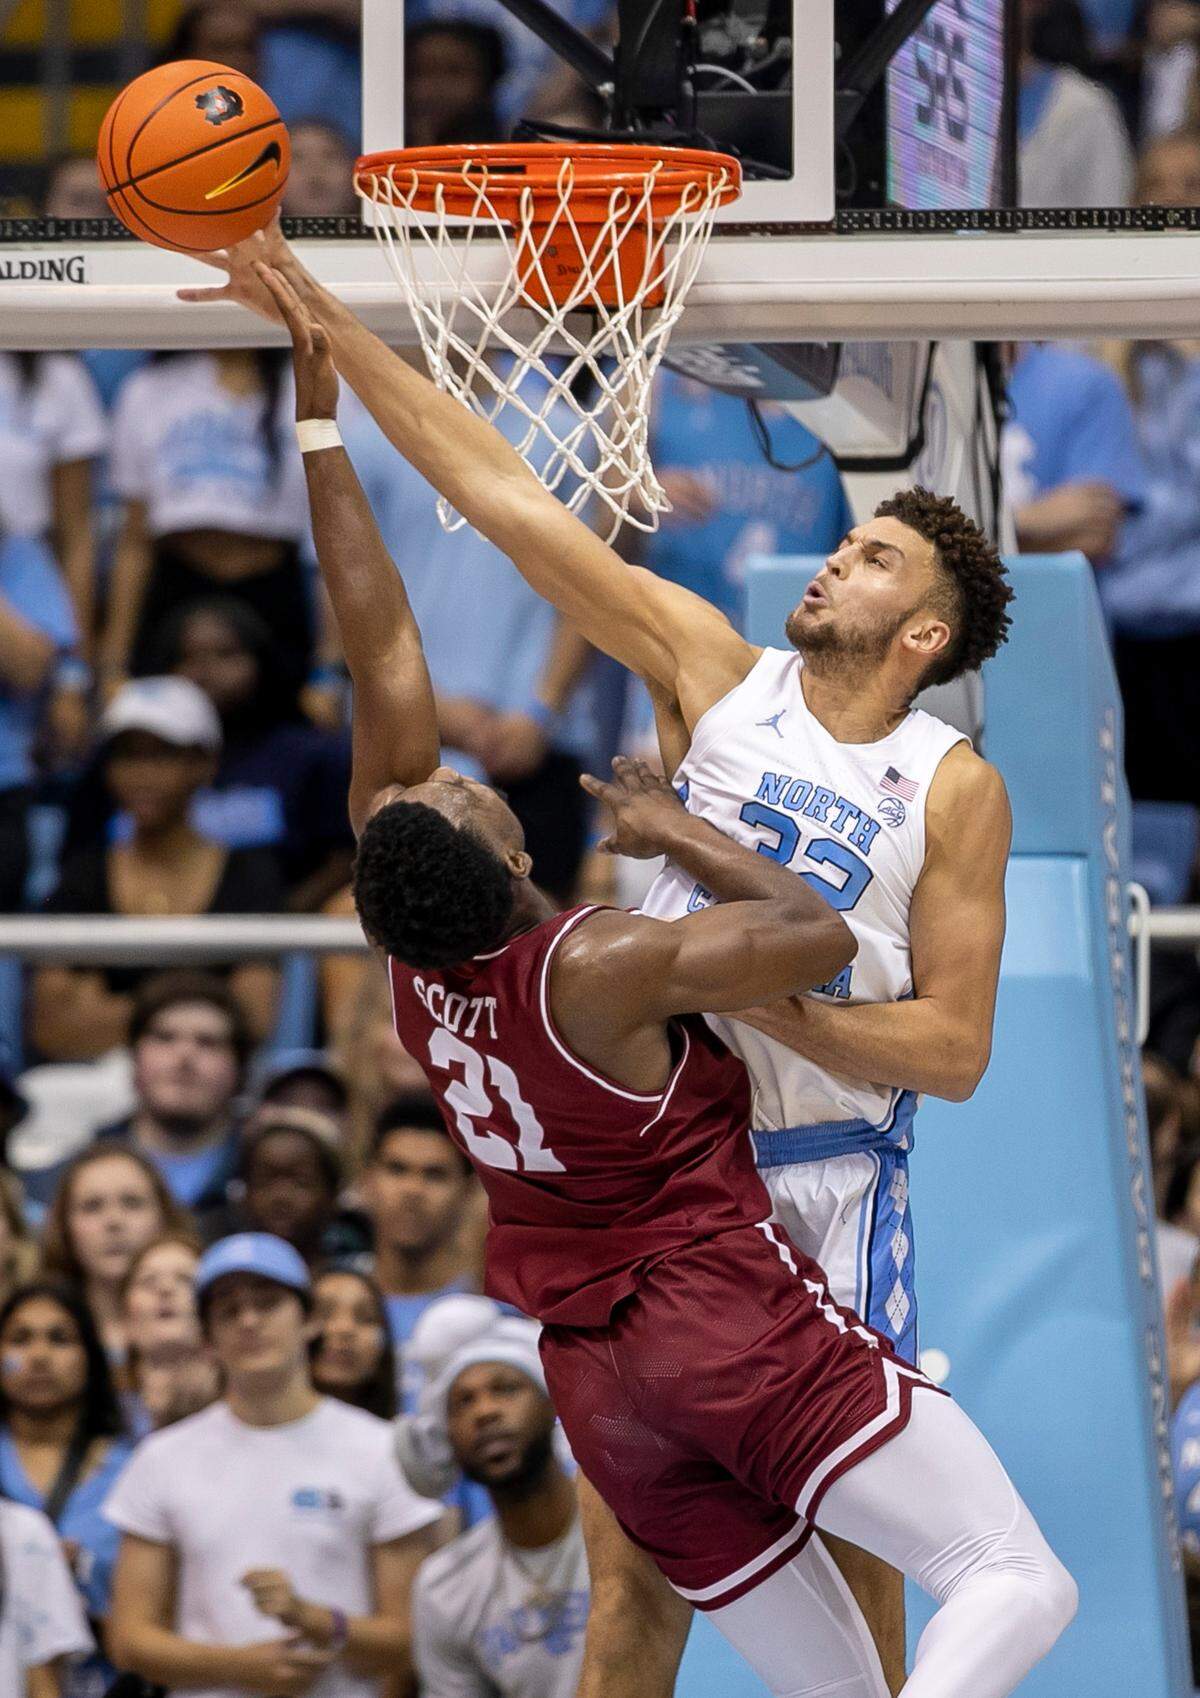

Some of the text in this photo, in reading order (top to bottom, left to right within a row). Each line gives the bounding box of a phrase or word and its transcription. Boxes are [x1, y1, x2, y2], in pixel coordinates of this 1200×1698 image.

[755, 772, 881, 856] NORTH
[413, 975, 498, 1040] SCOTT
[427, 1026, 567, 1173] 21
